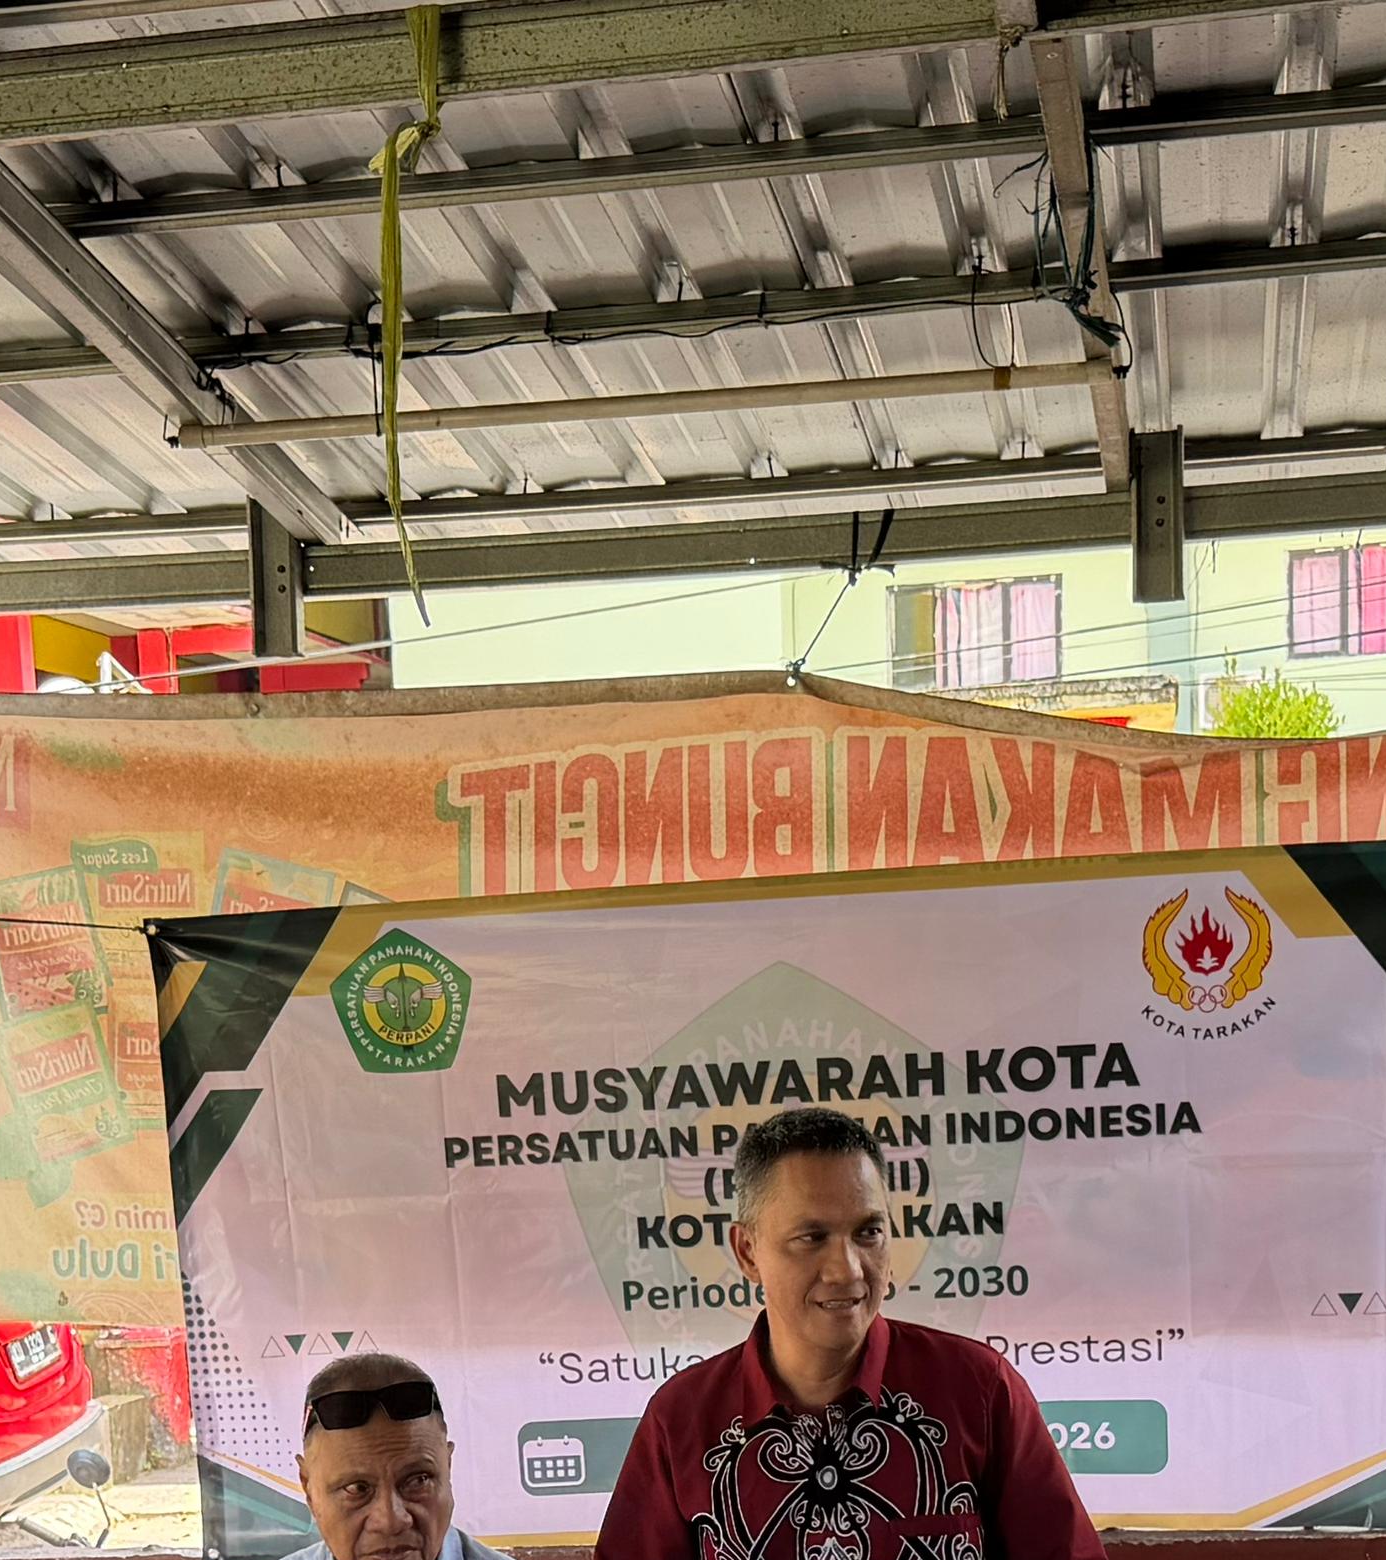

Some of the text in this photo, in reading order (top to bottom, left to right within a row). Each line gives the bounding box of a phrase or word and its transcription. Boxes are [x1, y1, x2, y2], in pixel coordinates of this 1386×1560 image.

[347, 945, 462, 1047] PERSATUAN PANAHAN INDONESIA
[378, 1022, 436, 1043] PERPANI
[1141, 996, 1277, 1041] KOTA TARAKAN
[374, 1042, 445, 1067] TARAKAN
[494, 1040, 1141, 1119] MUSYAWARAH KOTA
[443, 1124, 699, 1169] PERSATUAN
[945, 1101, 1202, 1146] INDONESIA
[636, 1212, 733, 1250] KOT
[932, 1264, 1029, 1300] 2030
[1047, 1421, 1116, 1450] 026
